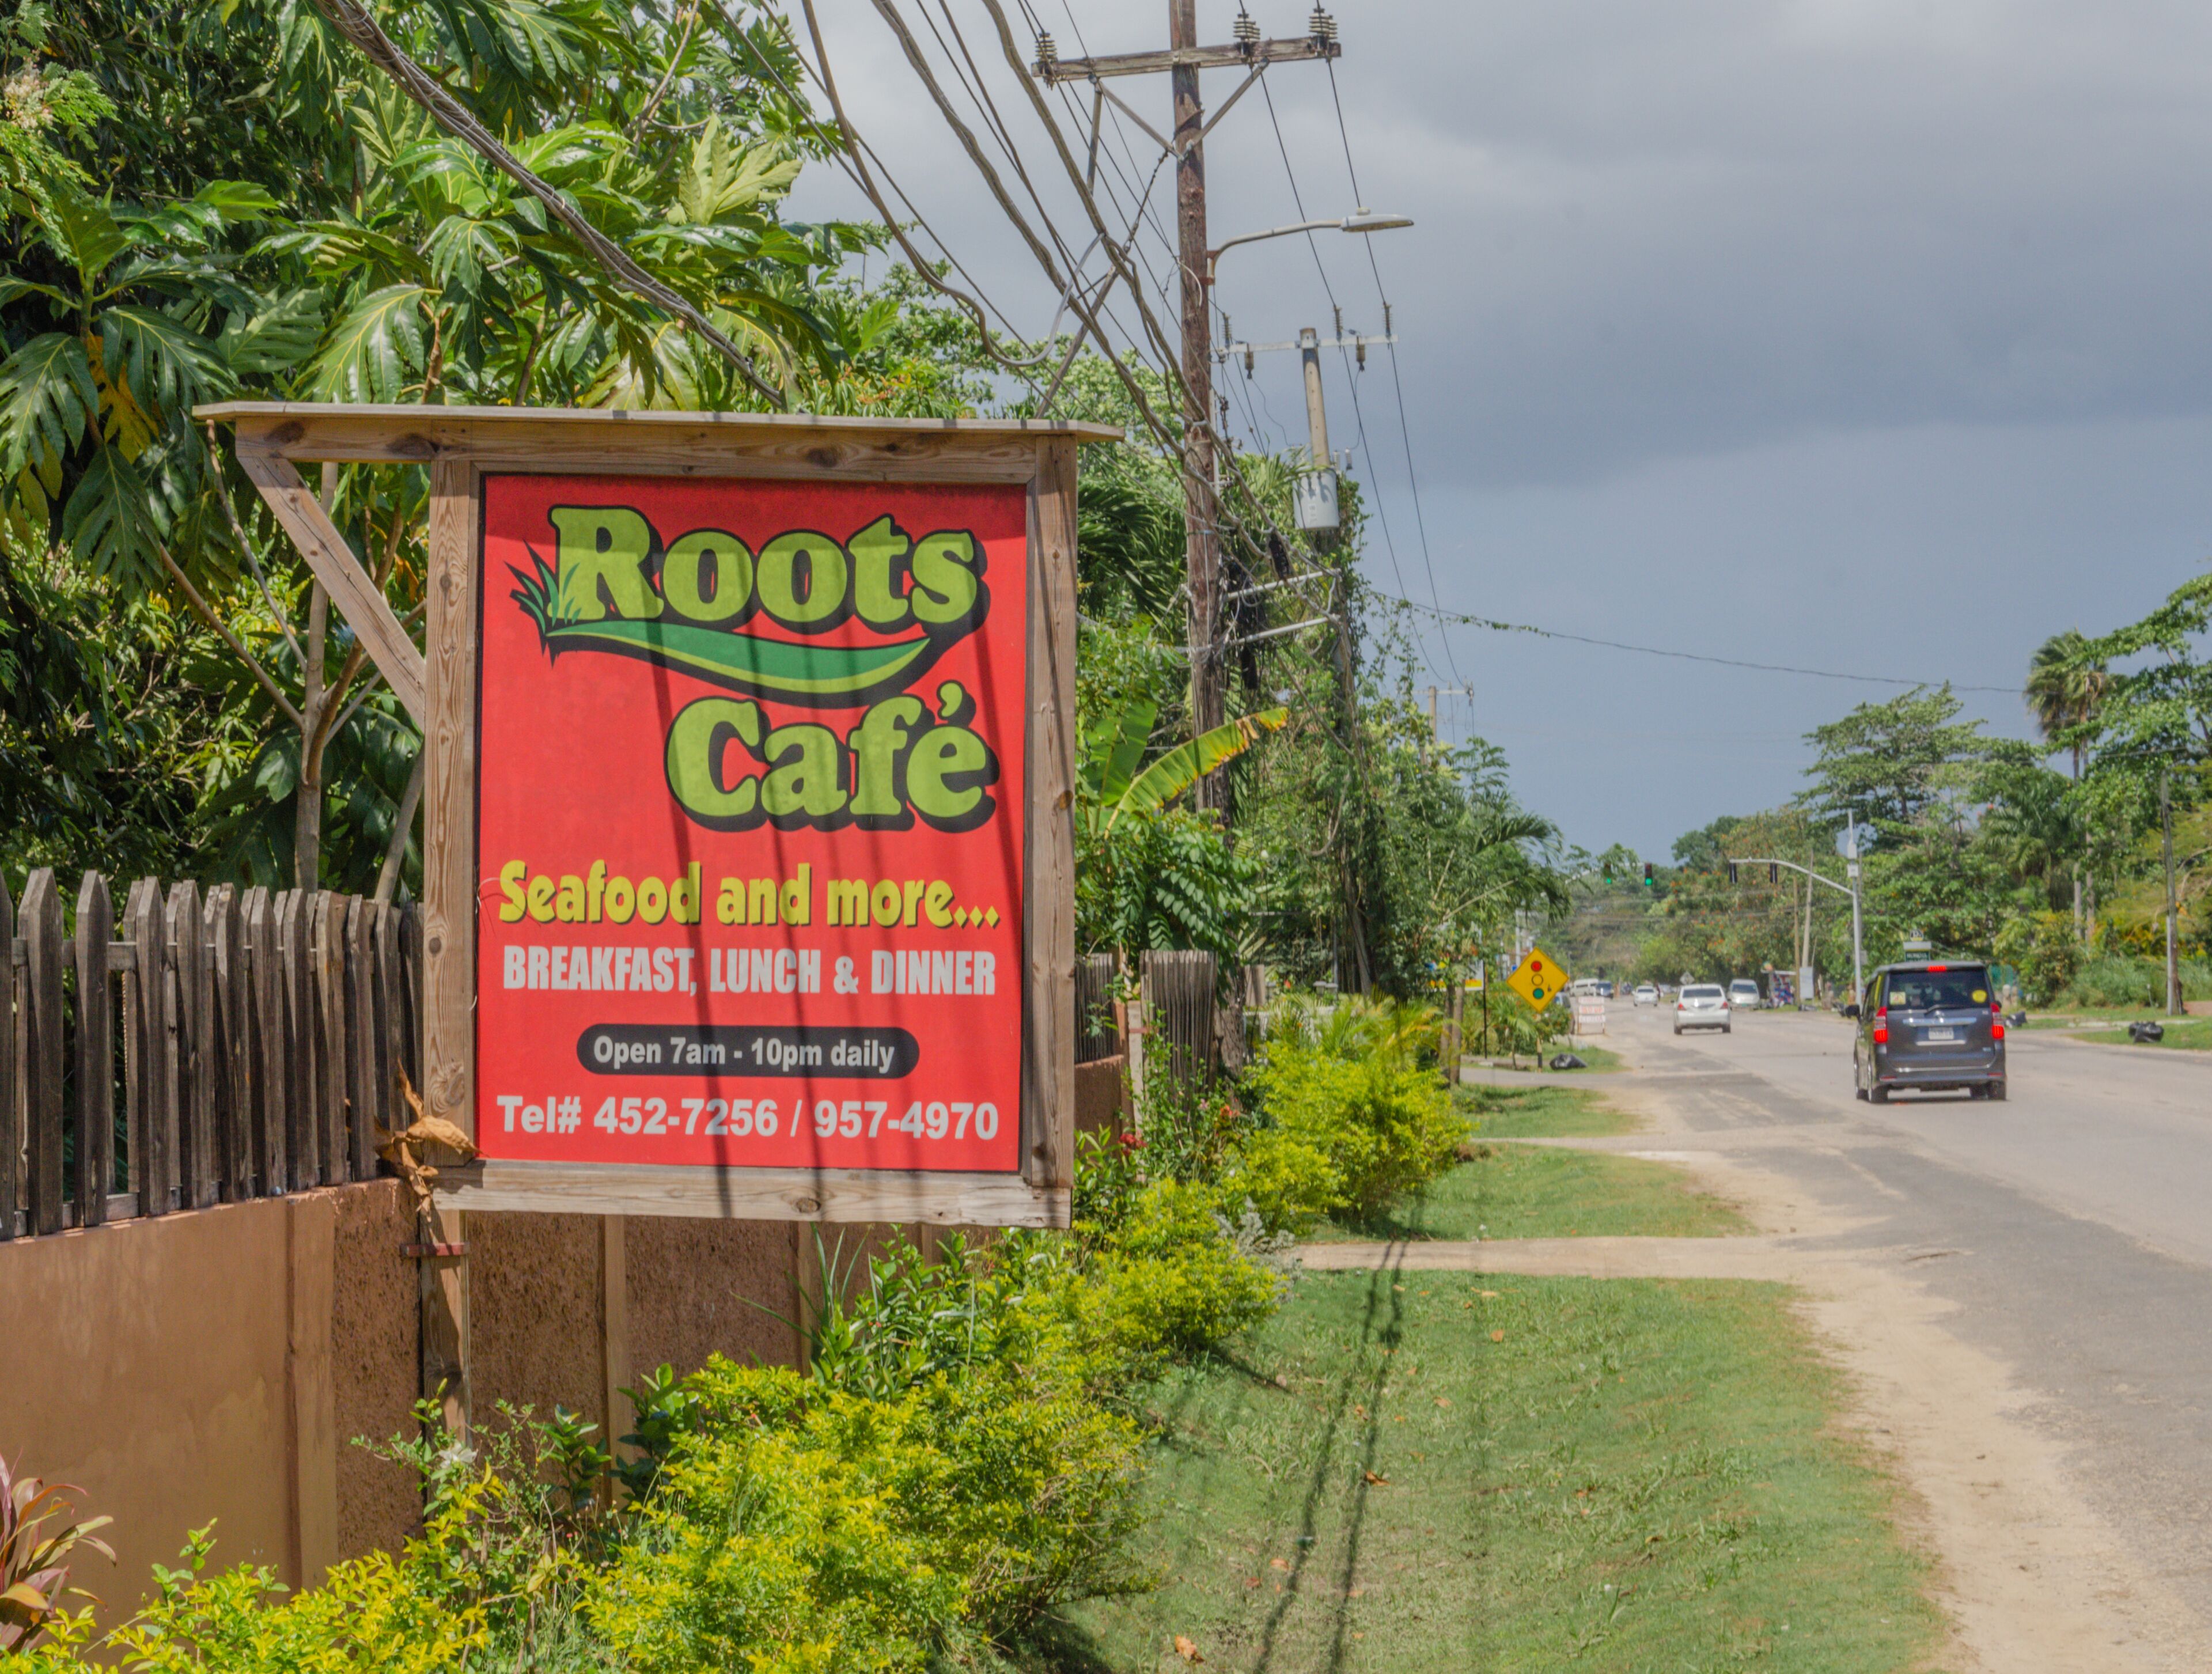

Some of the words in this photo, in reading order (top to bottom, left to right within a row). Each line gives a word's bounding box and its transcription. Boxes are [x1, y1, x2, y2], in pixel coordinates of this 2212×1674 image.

[546, 506, 980, 626] Roots
[665, 681, 988, 819] Café
[498, 859, 701, 924] Seafood
[716, 862, 810, 925] and
[827, 877, 999, 929] more...
[503, 945, 697, 997] BREAKFAST,
[710, 948, 821, 993] LUNCH
[834, 956, 858, 994] &
[871, 950, 995, 995] DINNER
[593, 1035, 662, 1069] Open
[670, 1036, 726, 1065] 7am
[751, 1037, 823, 1072] 10pm
[830, 1039, 895, 1074] daily
[497, 1095, 581, 1134] Tel#
[594, 1097, 778, 1137] 452-7256
[790, 1100, 802, 1137] /
[815, 1100, 998, 1140] 957-4970
